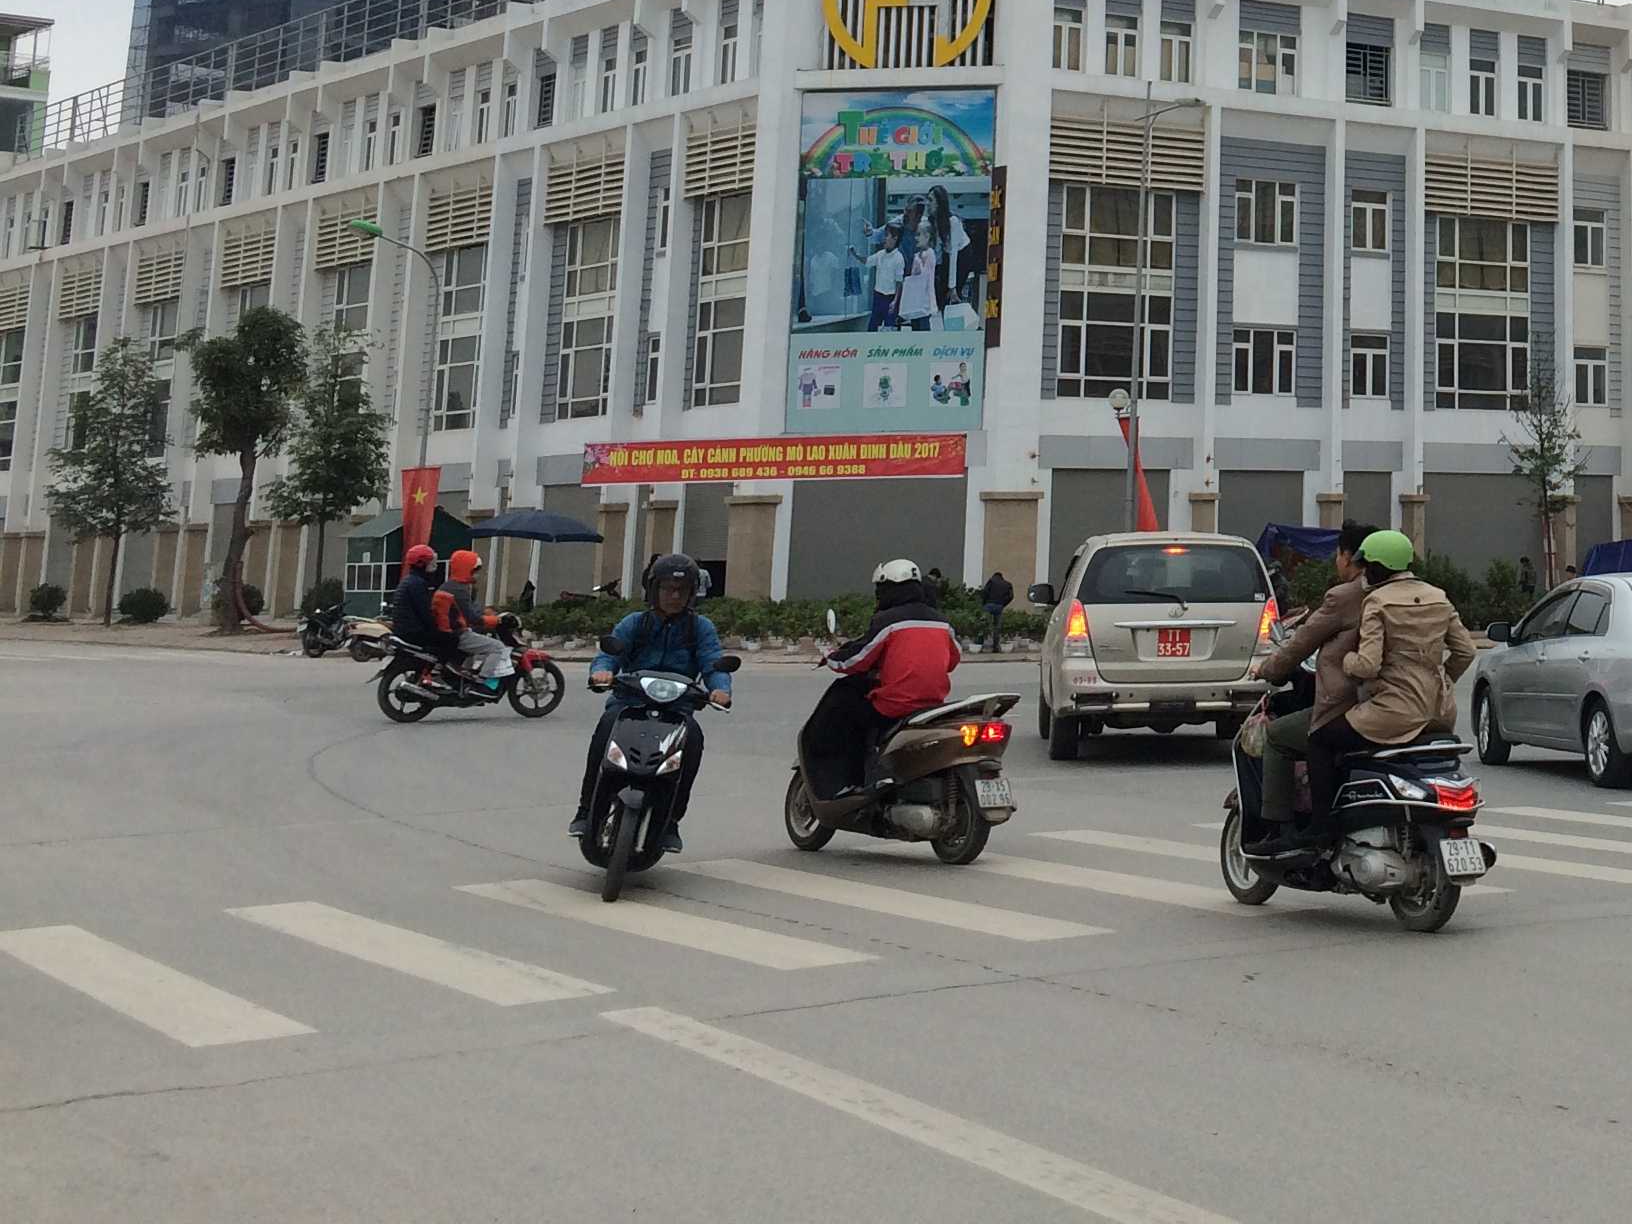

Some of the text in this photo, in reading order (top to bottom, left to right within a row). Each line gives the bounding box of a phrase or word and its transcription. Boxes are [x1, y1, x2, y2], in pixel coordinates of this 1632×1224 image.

[806, 445, 825, 461] LAO
[914, 442, 941, 459] 2017
[1158, 642, 1190, 656] 33-57
